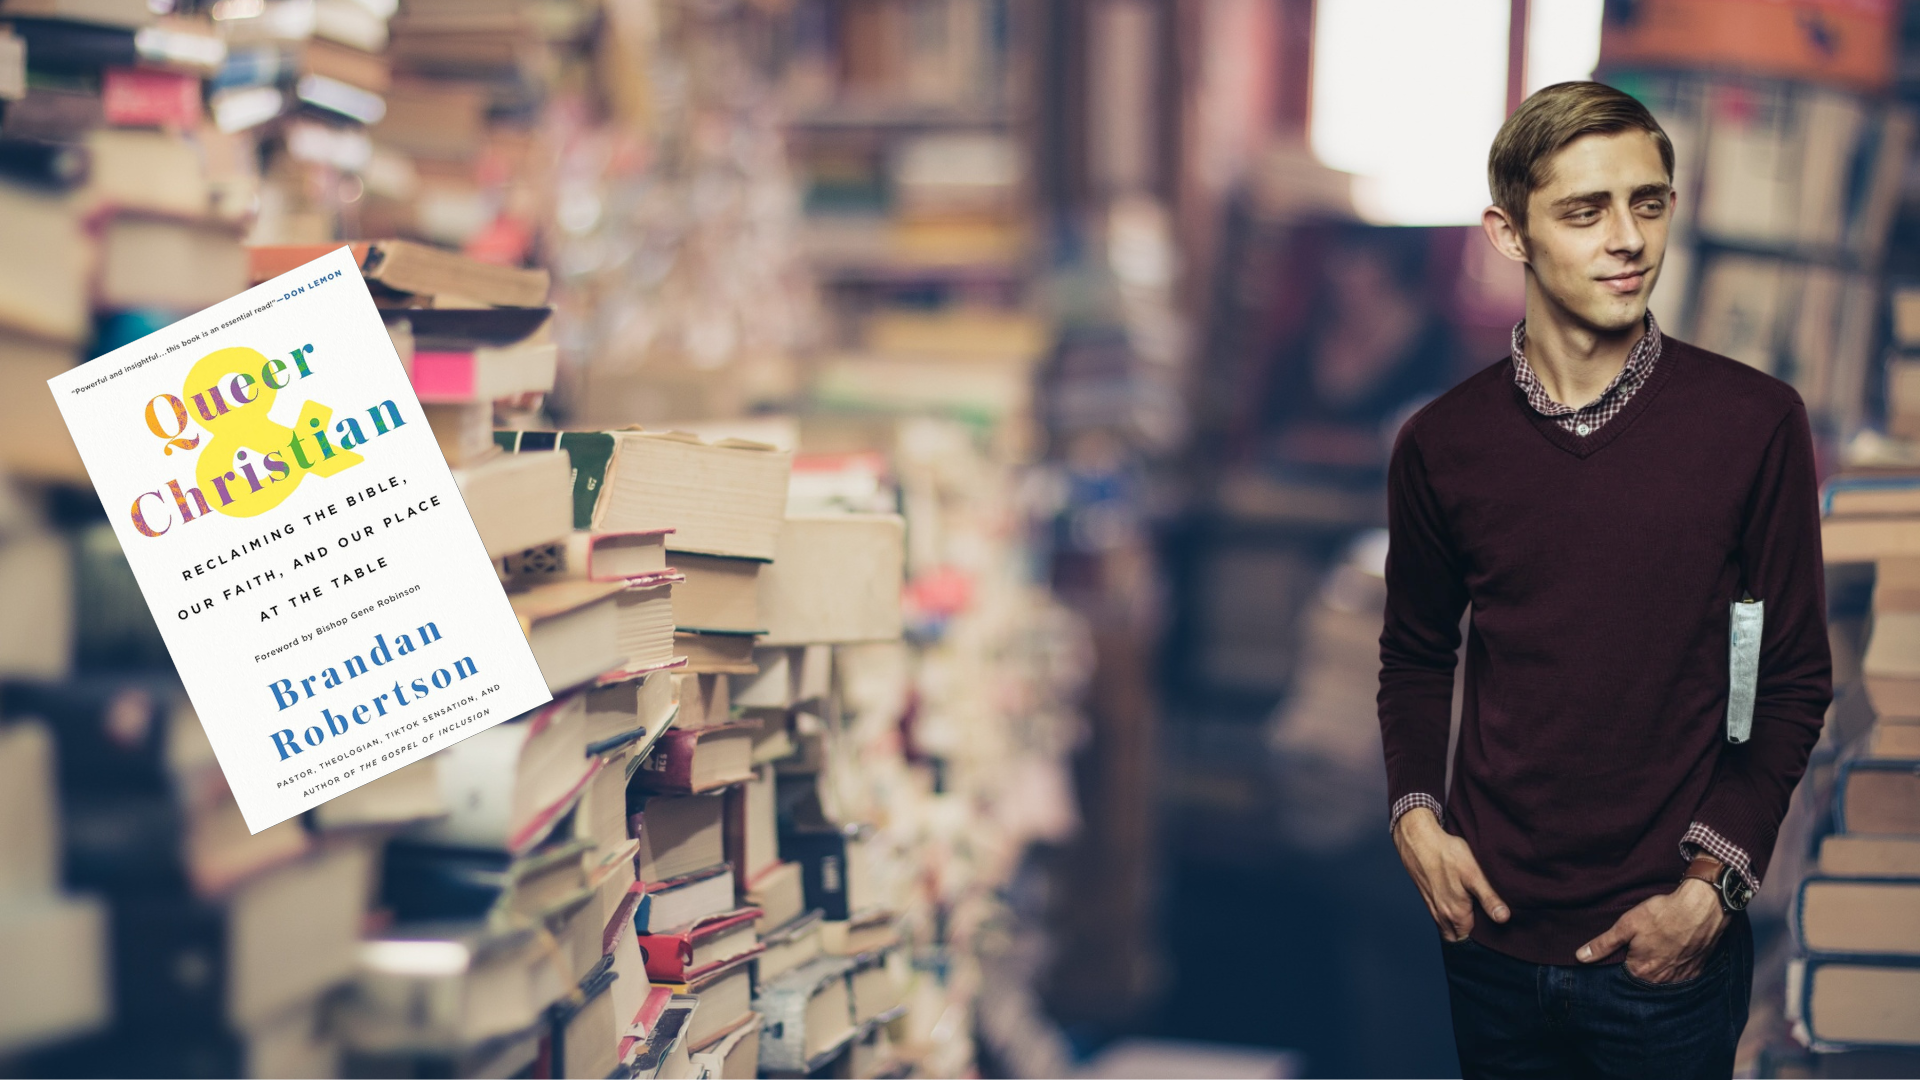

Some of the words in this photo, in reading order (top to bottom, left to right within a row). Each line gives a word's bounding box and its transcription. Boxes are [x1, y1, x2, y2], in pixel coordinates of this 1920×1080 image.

[108, 368, 124, 380] and
[180, 334, 202, 347] book
[209, 326, 220, 335] an
[220, 309, 254, 330] essential
[307, 269, 343, 290] LEMON
[145, 344, 314, 455] Queer
[183, 347, 364, 517] &
[131, 400, 406, 537] Christian
[178, 598, 214, 620] OUR
[223, 570, 283, 600] FAITH,
[294, 547, 328, 570] AND
[338, 526, 375, 548] OUR
[383, 495, 440, 528] PLACE
[182, 524, 295, 581] RECLAIMING
[303, 504, 337, 525] THE
[346, 476, 406, 507] BIBLE,
[254, 637, 300, 664] Foreword
[300, 632, 313, 643] by
[315, 617, 349, 636] Bishop
[350, 605, 375, 620] Gene
[376, 584, 421, 609] Robinson
[261, 605, 278, 622] AT
[288, 586, 323, 607] THE
[331, 557, 387, 588] TABLE
[268, 622, 442, 711] Brandan
[269, 656, 479, 762] Robertson
[276, 768, 317, 789] PASTOR,
[318, 738, 383, 770] THEOLOGIAN,
[384, 719, 420, 740] TIKTOK
[421, 695, 479, 724] SENSATION,
[481, 683, 501, 698] AND
[303, 775, 341, 798] AUTHOR
[343, 768, 356, 779] OF
[359, 758, 378, 772] THE
[381, 741, 419, 762] GOSPEL
[421, 732, 435, 744] OF
[438, 707, 490, 737] INCLUSION
